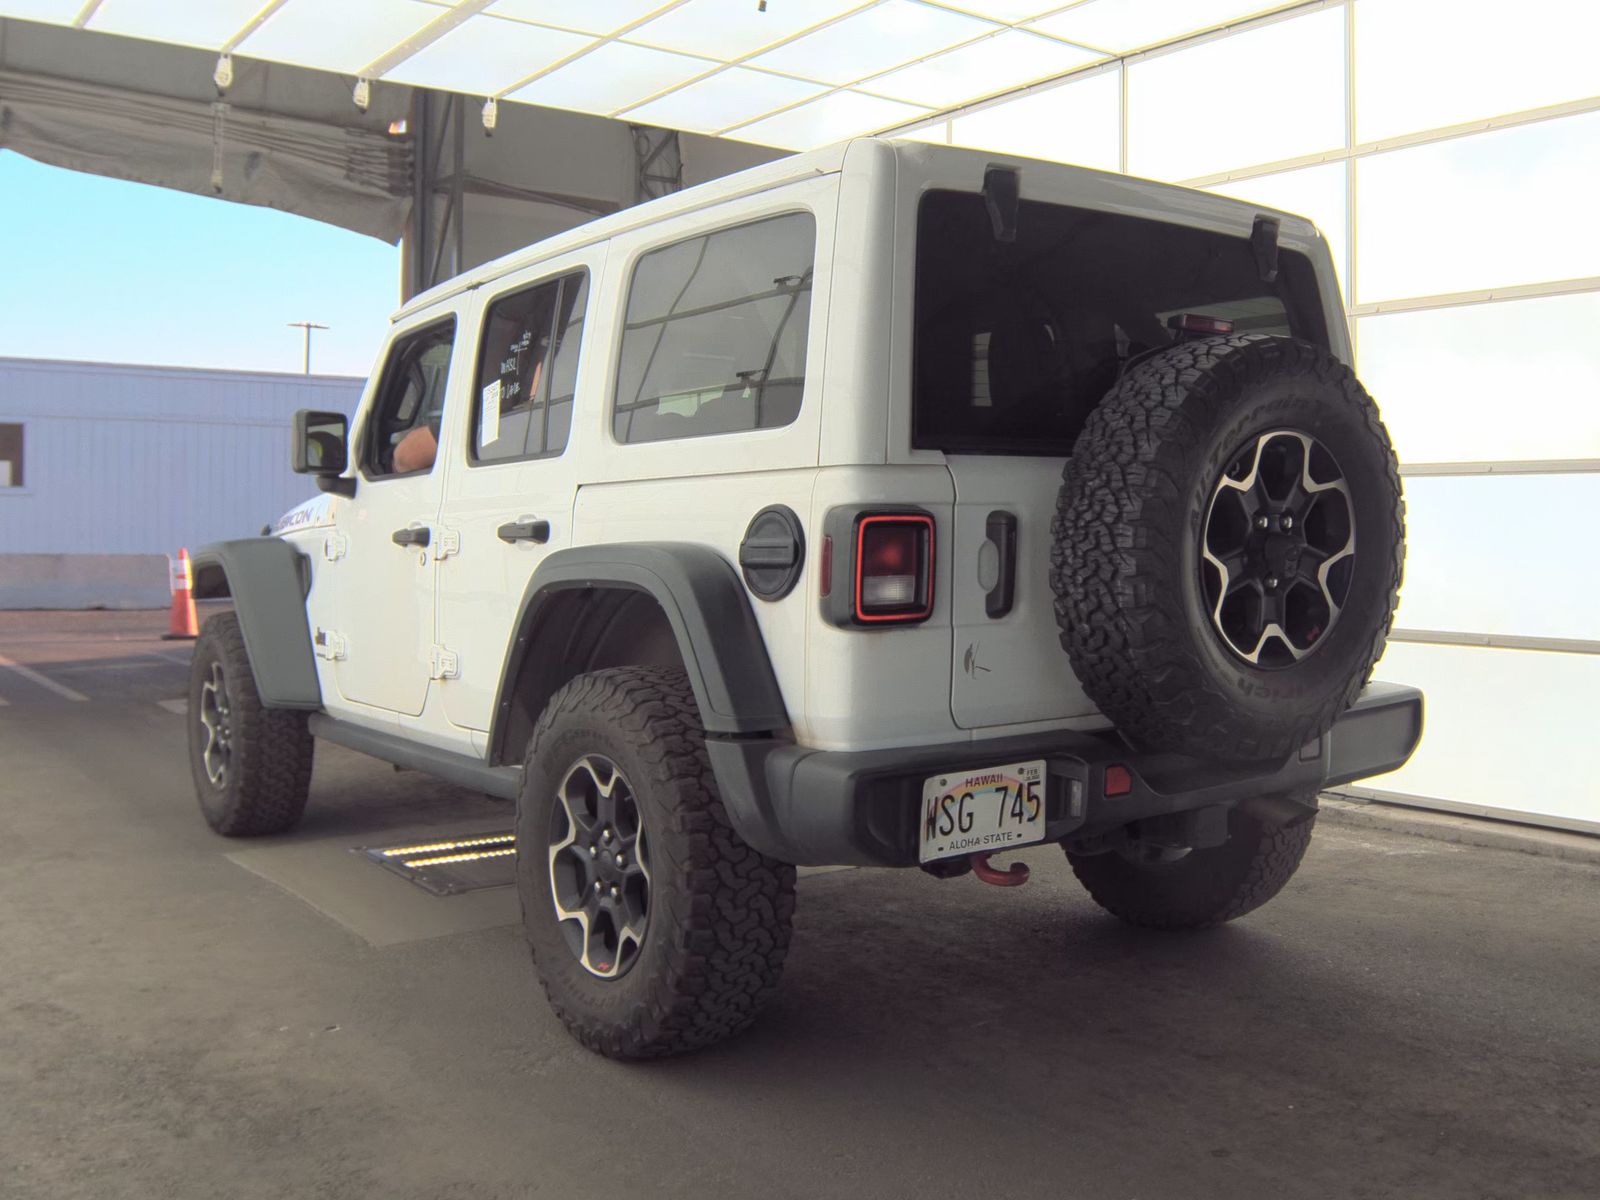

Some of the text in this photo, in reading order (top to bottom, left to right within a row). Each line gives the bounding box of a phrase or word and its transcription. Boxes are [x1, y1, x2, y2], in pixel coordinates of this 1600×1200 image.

[965, 773, 1003, 788] HAWAII
[926, 780, 1041, 842] WSG 745
[949, 832, 1013, 850] ALOHA STATE
